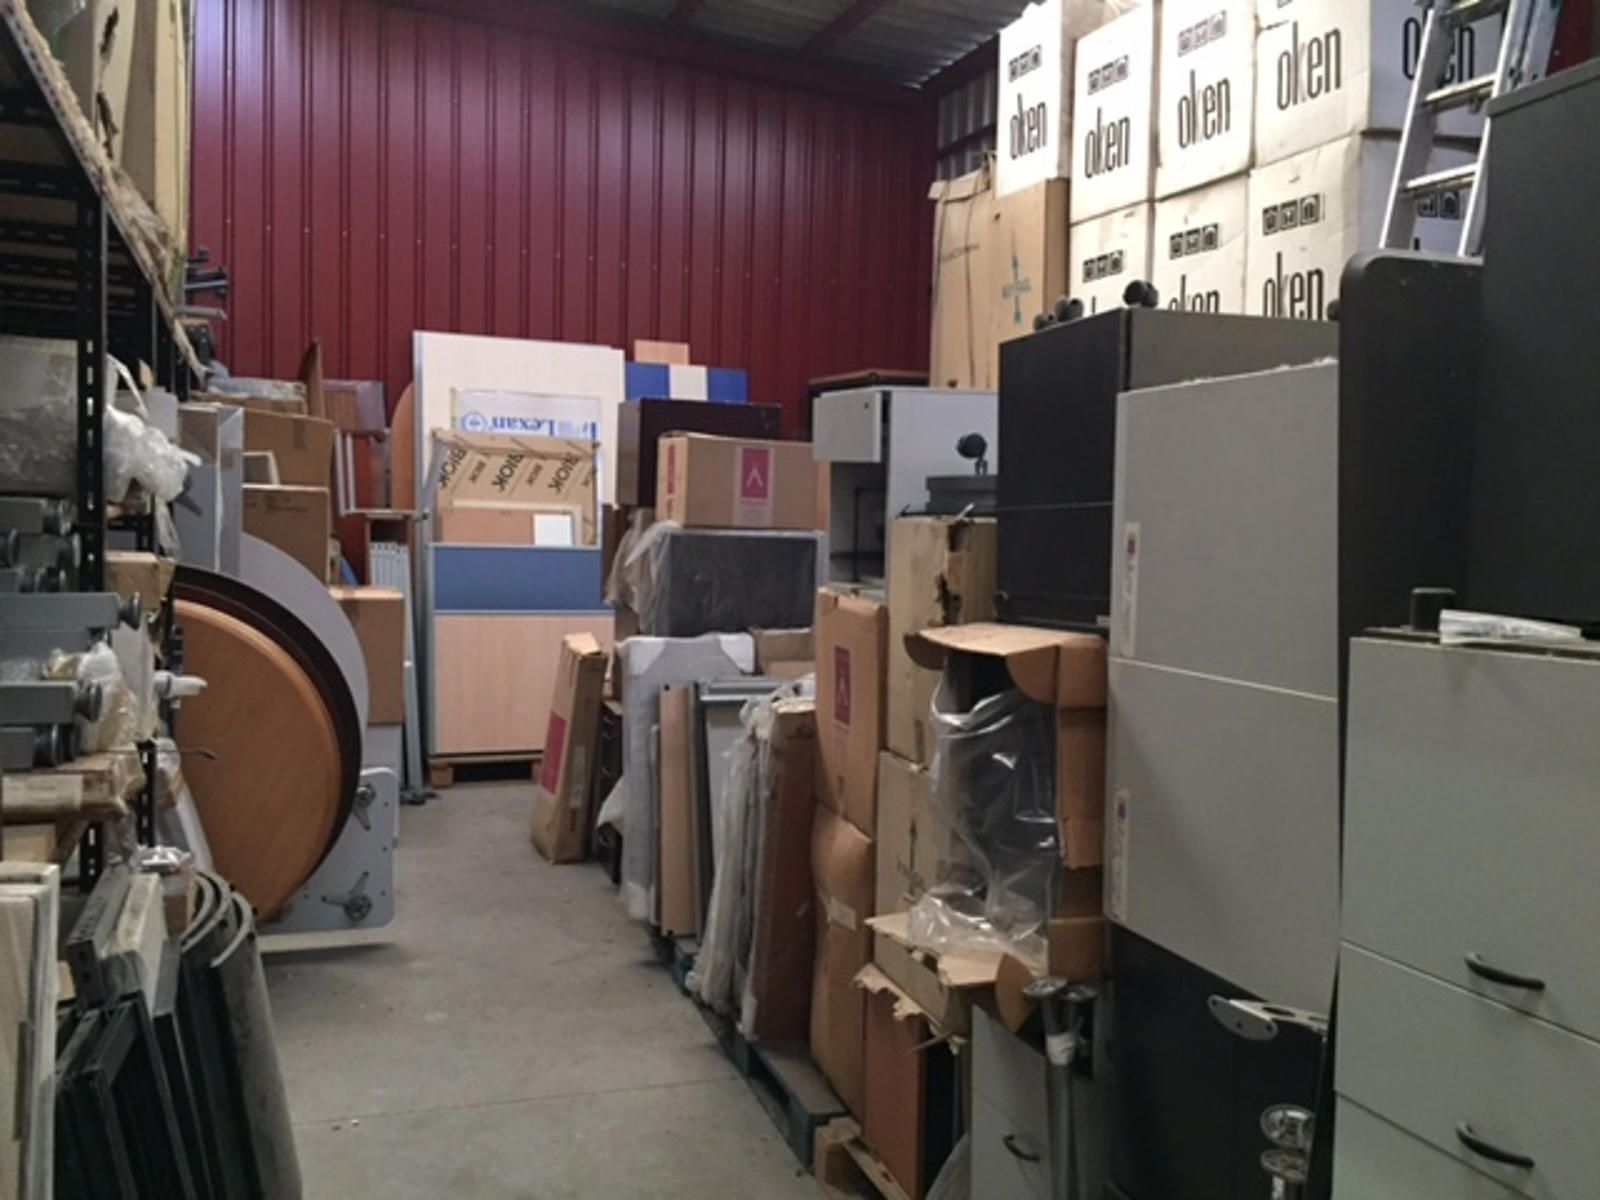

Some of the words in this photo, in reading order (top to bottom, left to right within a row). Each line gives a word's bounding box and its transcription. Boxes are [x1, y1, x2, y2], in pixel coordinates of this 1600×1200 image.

[1277, 20, 1341, 110] oken
[1010, 93, 1047, 160] oken
[1085, 107, 1130, 179] oken
[1178, 69, 1230, 149] oken
[491, 416, 554, 436] Lexan
